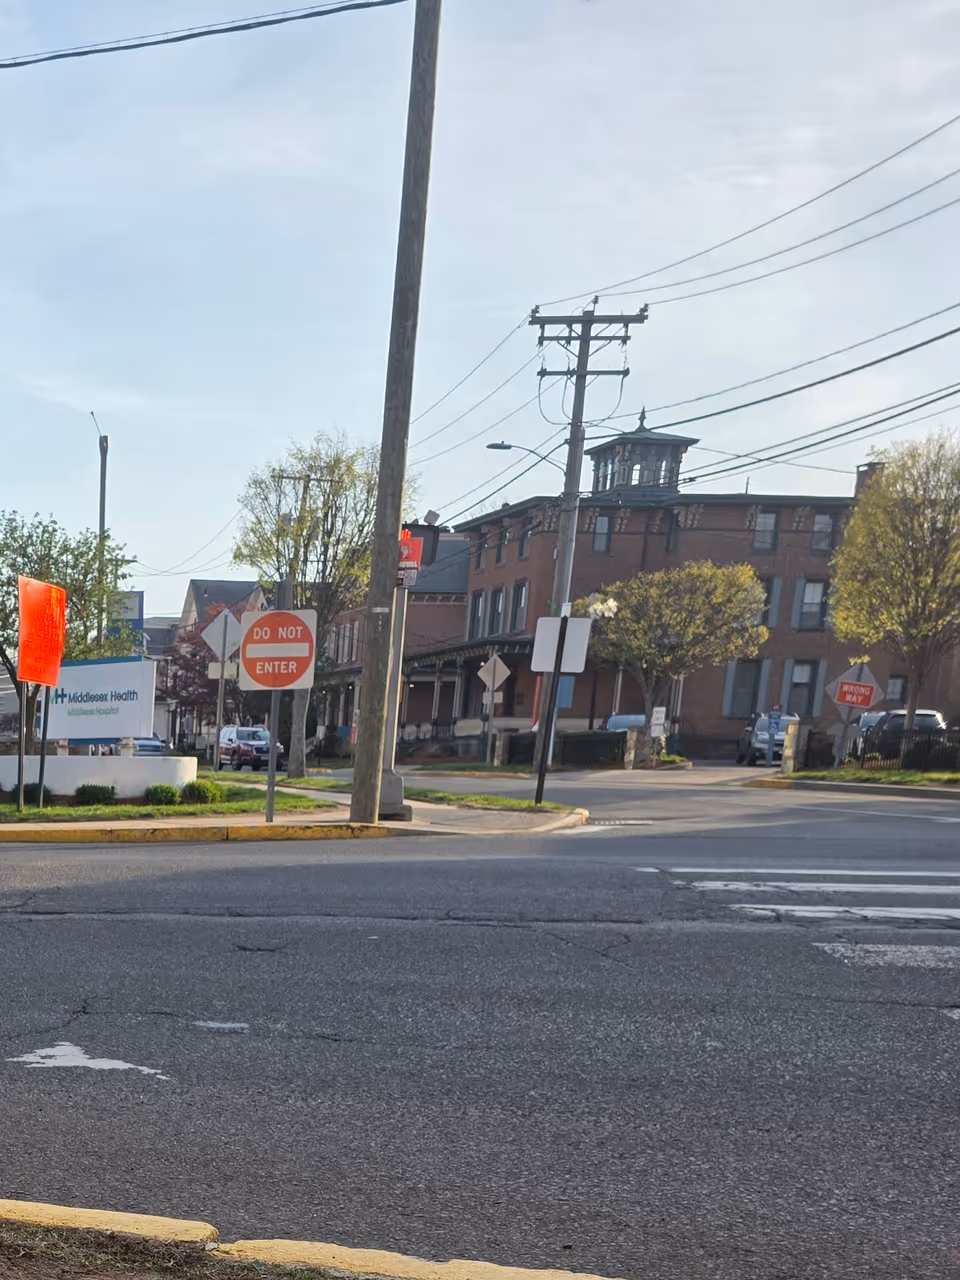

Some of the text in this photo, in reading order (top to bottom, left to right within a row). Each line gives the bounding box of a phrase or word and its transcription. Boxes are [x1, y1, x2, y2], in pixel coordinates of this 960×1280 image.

[253, 626, 303, 640] DO NOT
[256, 661, 297, 674] ENTER
[68, 689, 138, 703] Middlesex Health
[842, 684, 871, 696] WRONG
[845, 694, 864, 703] WAY
